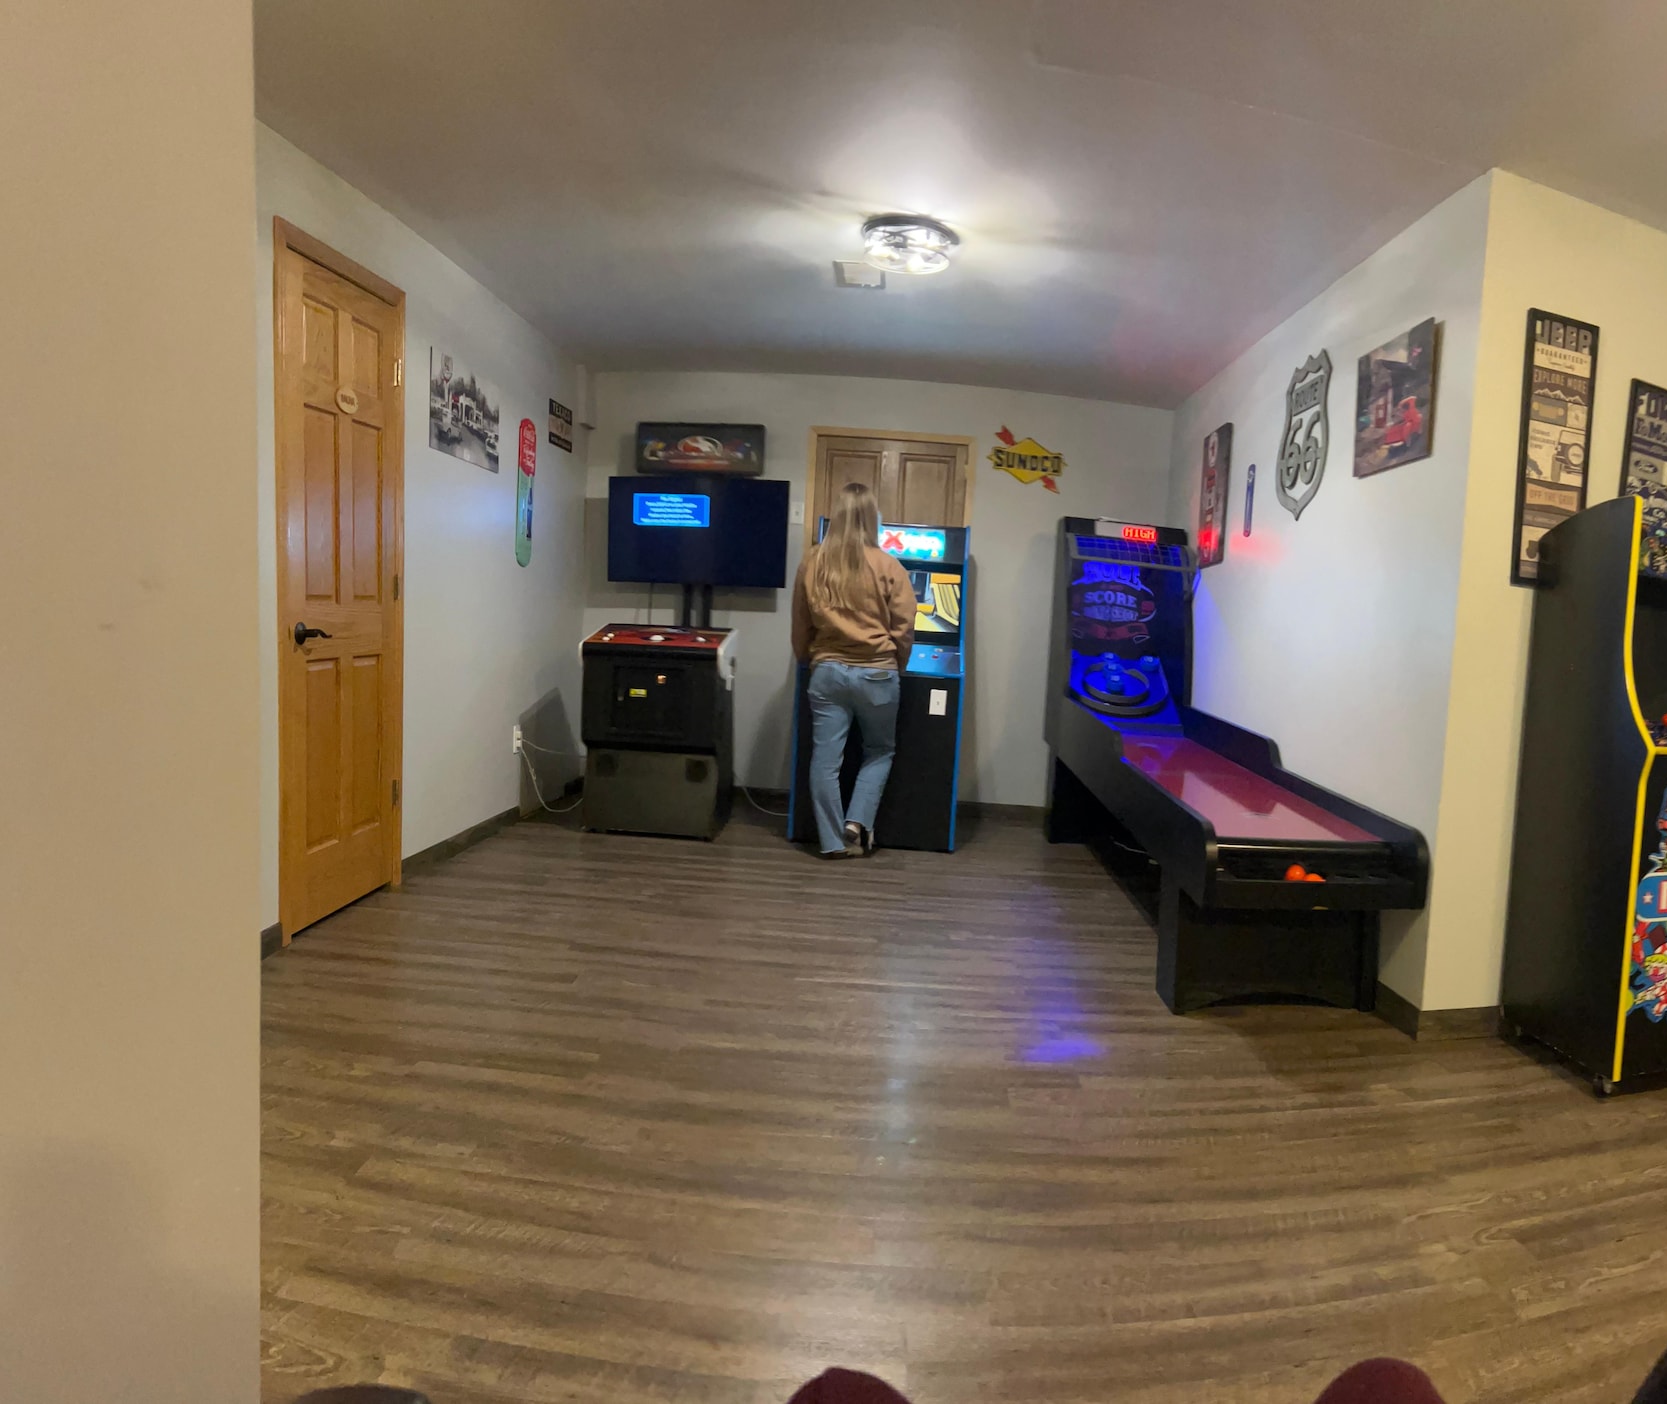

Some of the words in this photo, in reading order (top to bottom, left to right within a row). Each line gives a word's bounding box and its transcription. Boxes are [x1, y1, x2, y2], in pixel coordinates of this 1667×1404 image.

[1536, 319, 1592, 354] JEEP
[1540, 347, 1584, 365] GUARANTEED
[1294, 380, 1320, 409] ROUTE
[1533, 368, 1566, 386] EXPLORE
[1566, 376, 1588, 395] MORE
[993, 449, 1063, 474] SUNOCO
[1284, 410, 1321, 490] 66
[1124, 527, 1157, 540] HIGH
[1084, 591, 1138, 608] SCORE
